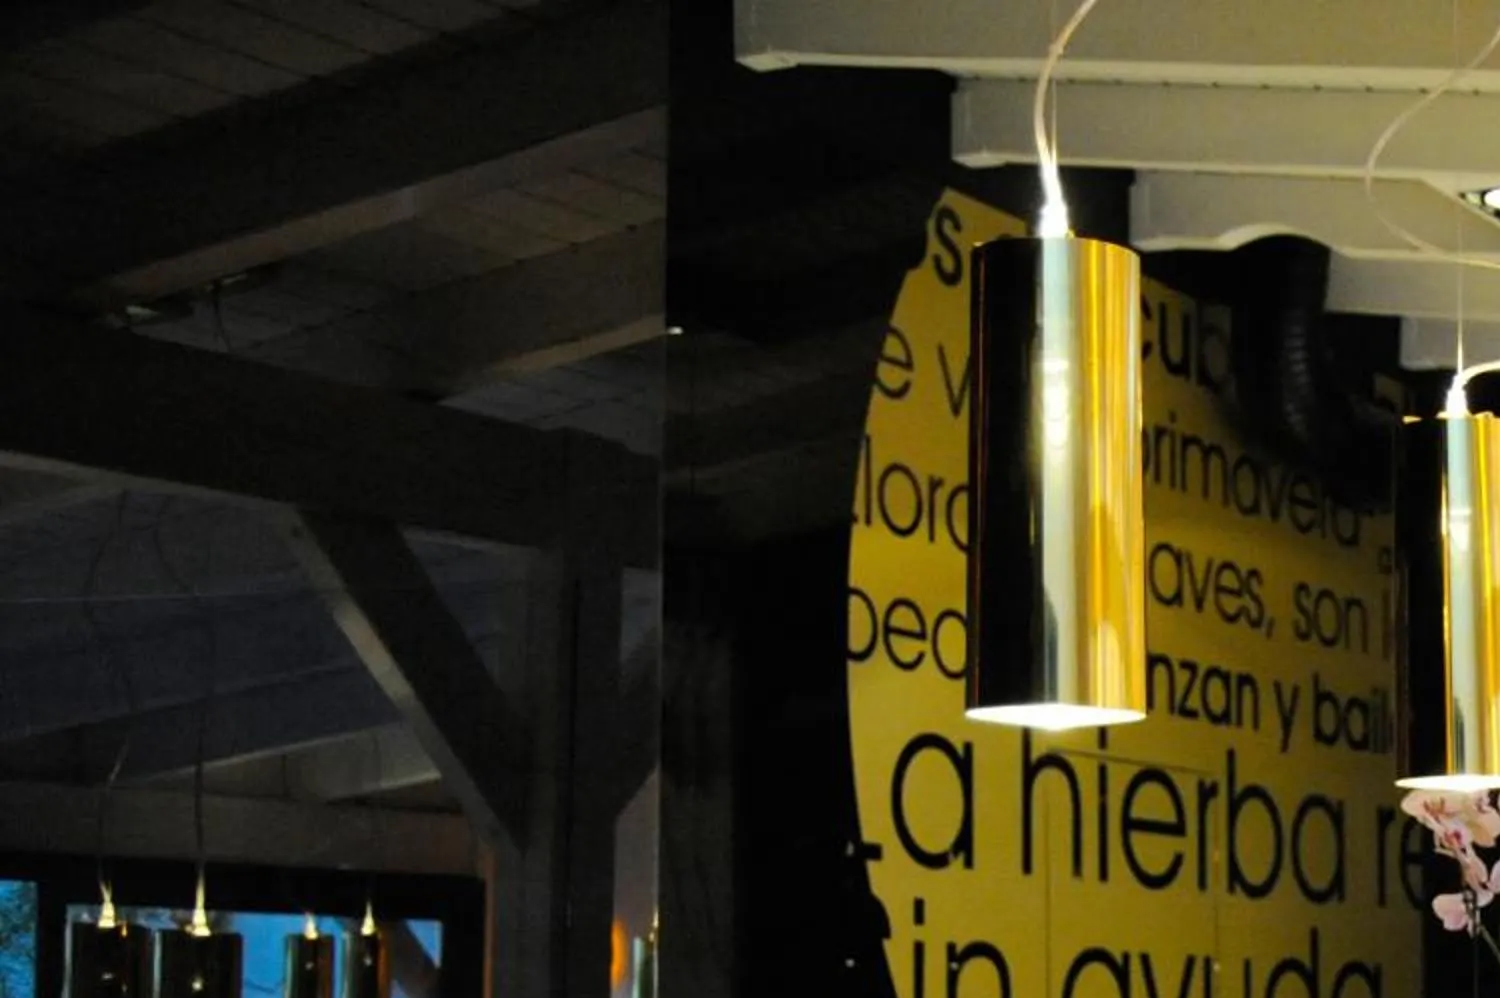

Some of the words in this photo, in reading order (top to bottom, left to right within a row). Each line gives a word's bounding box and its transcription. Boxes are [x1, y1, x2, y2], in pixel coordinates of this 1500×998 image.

[1148, 543, 1275, 640] aves,
[1292, 581, 1368, 653] son
[1274, 679, 1301, 752] y
[1021, 726, 1344, 903] hierba
